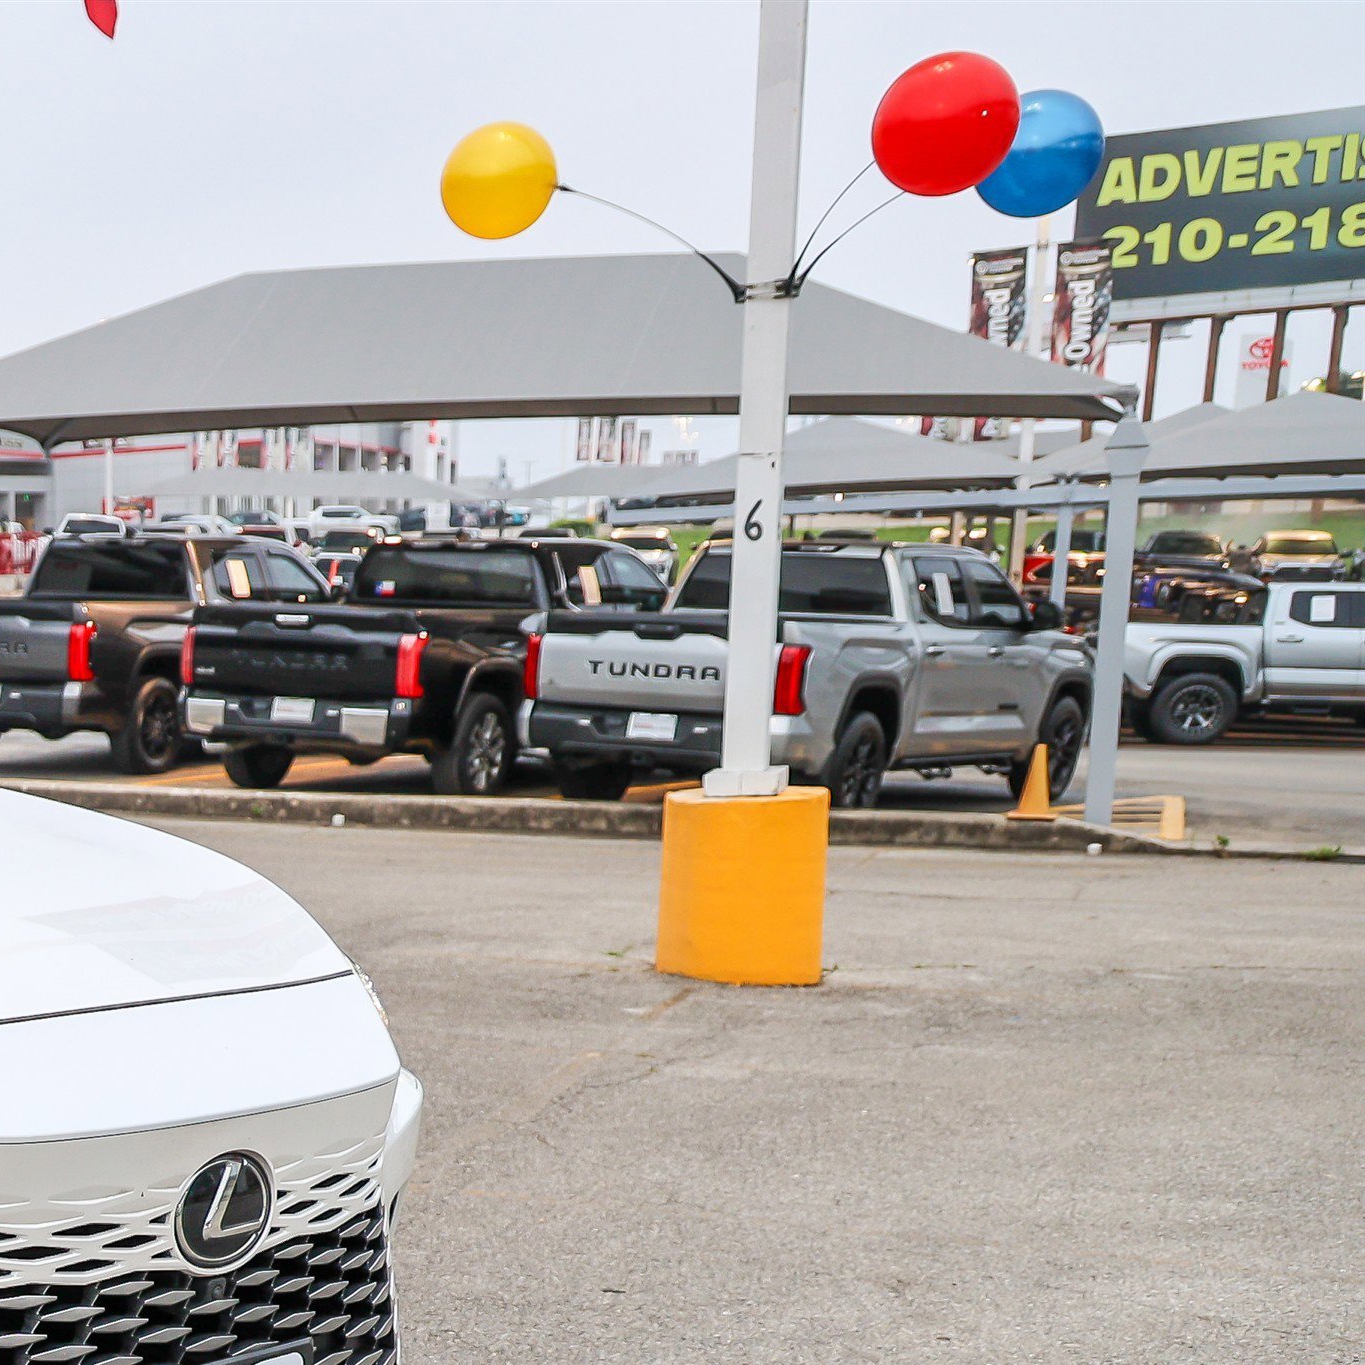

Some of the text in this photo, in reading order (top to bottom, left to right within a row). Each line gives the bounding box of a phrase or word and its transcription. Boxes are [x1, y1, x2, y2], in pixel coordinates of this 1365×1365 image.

[1096, 133, 1365, 207] ADVERTI
[744, 499, 763, 541] 6
[588, 660, 720, 681] TUNDRA
